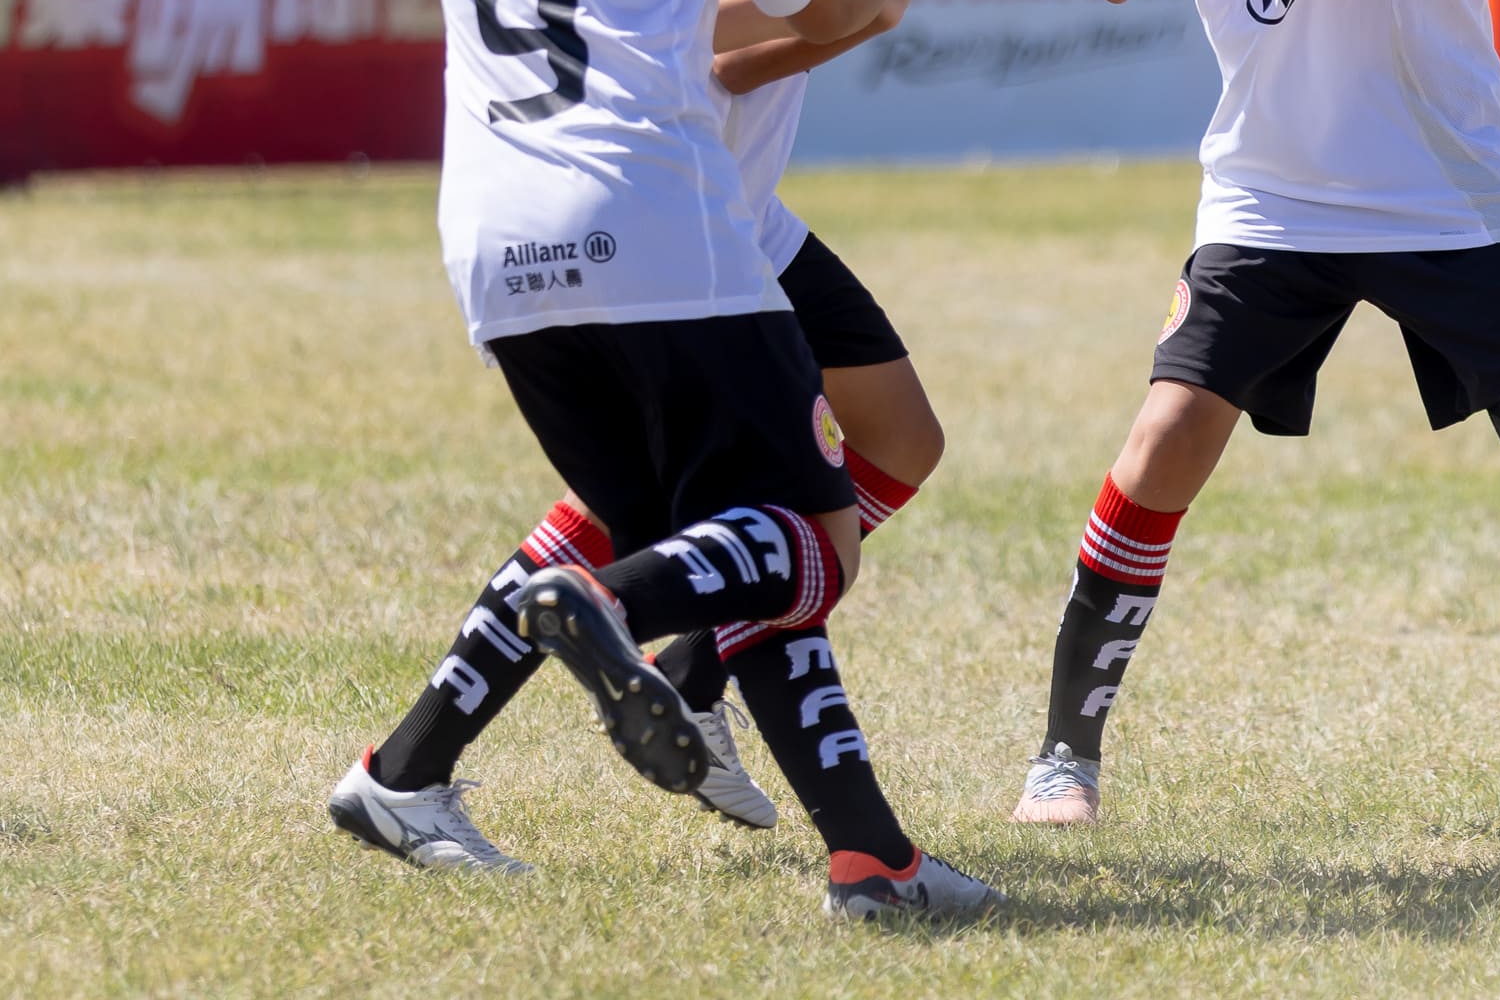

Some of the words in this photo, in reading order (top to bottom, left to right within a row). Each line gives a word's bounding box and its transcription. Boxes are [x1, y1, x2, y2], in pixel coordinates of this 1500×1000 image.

[504, 241, 578, 268] Allianz
[505, 268, 583, 296] 安聯人壽
